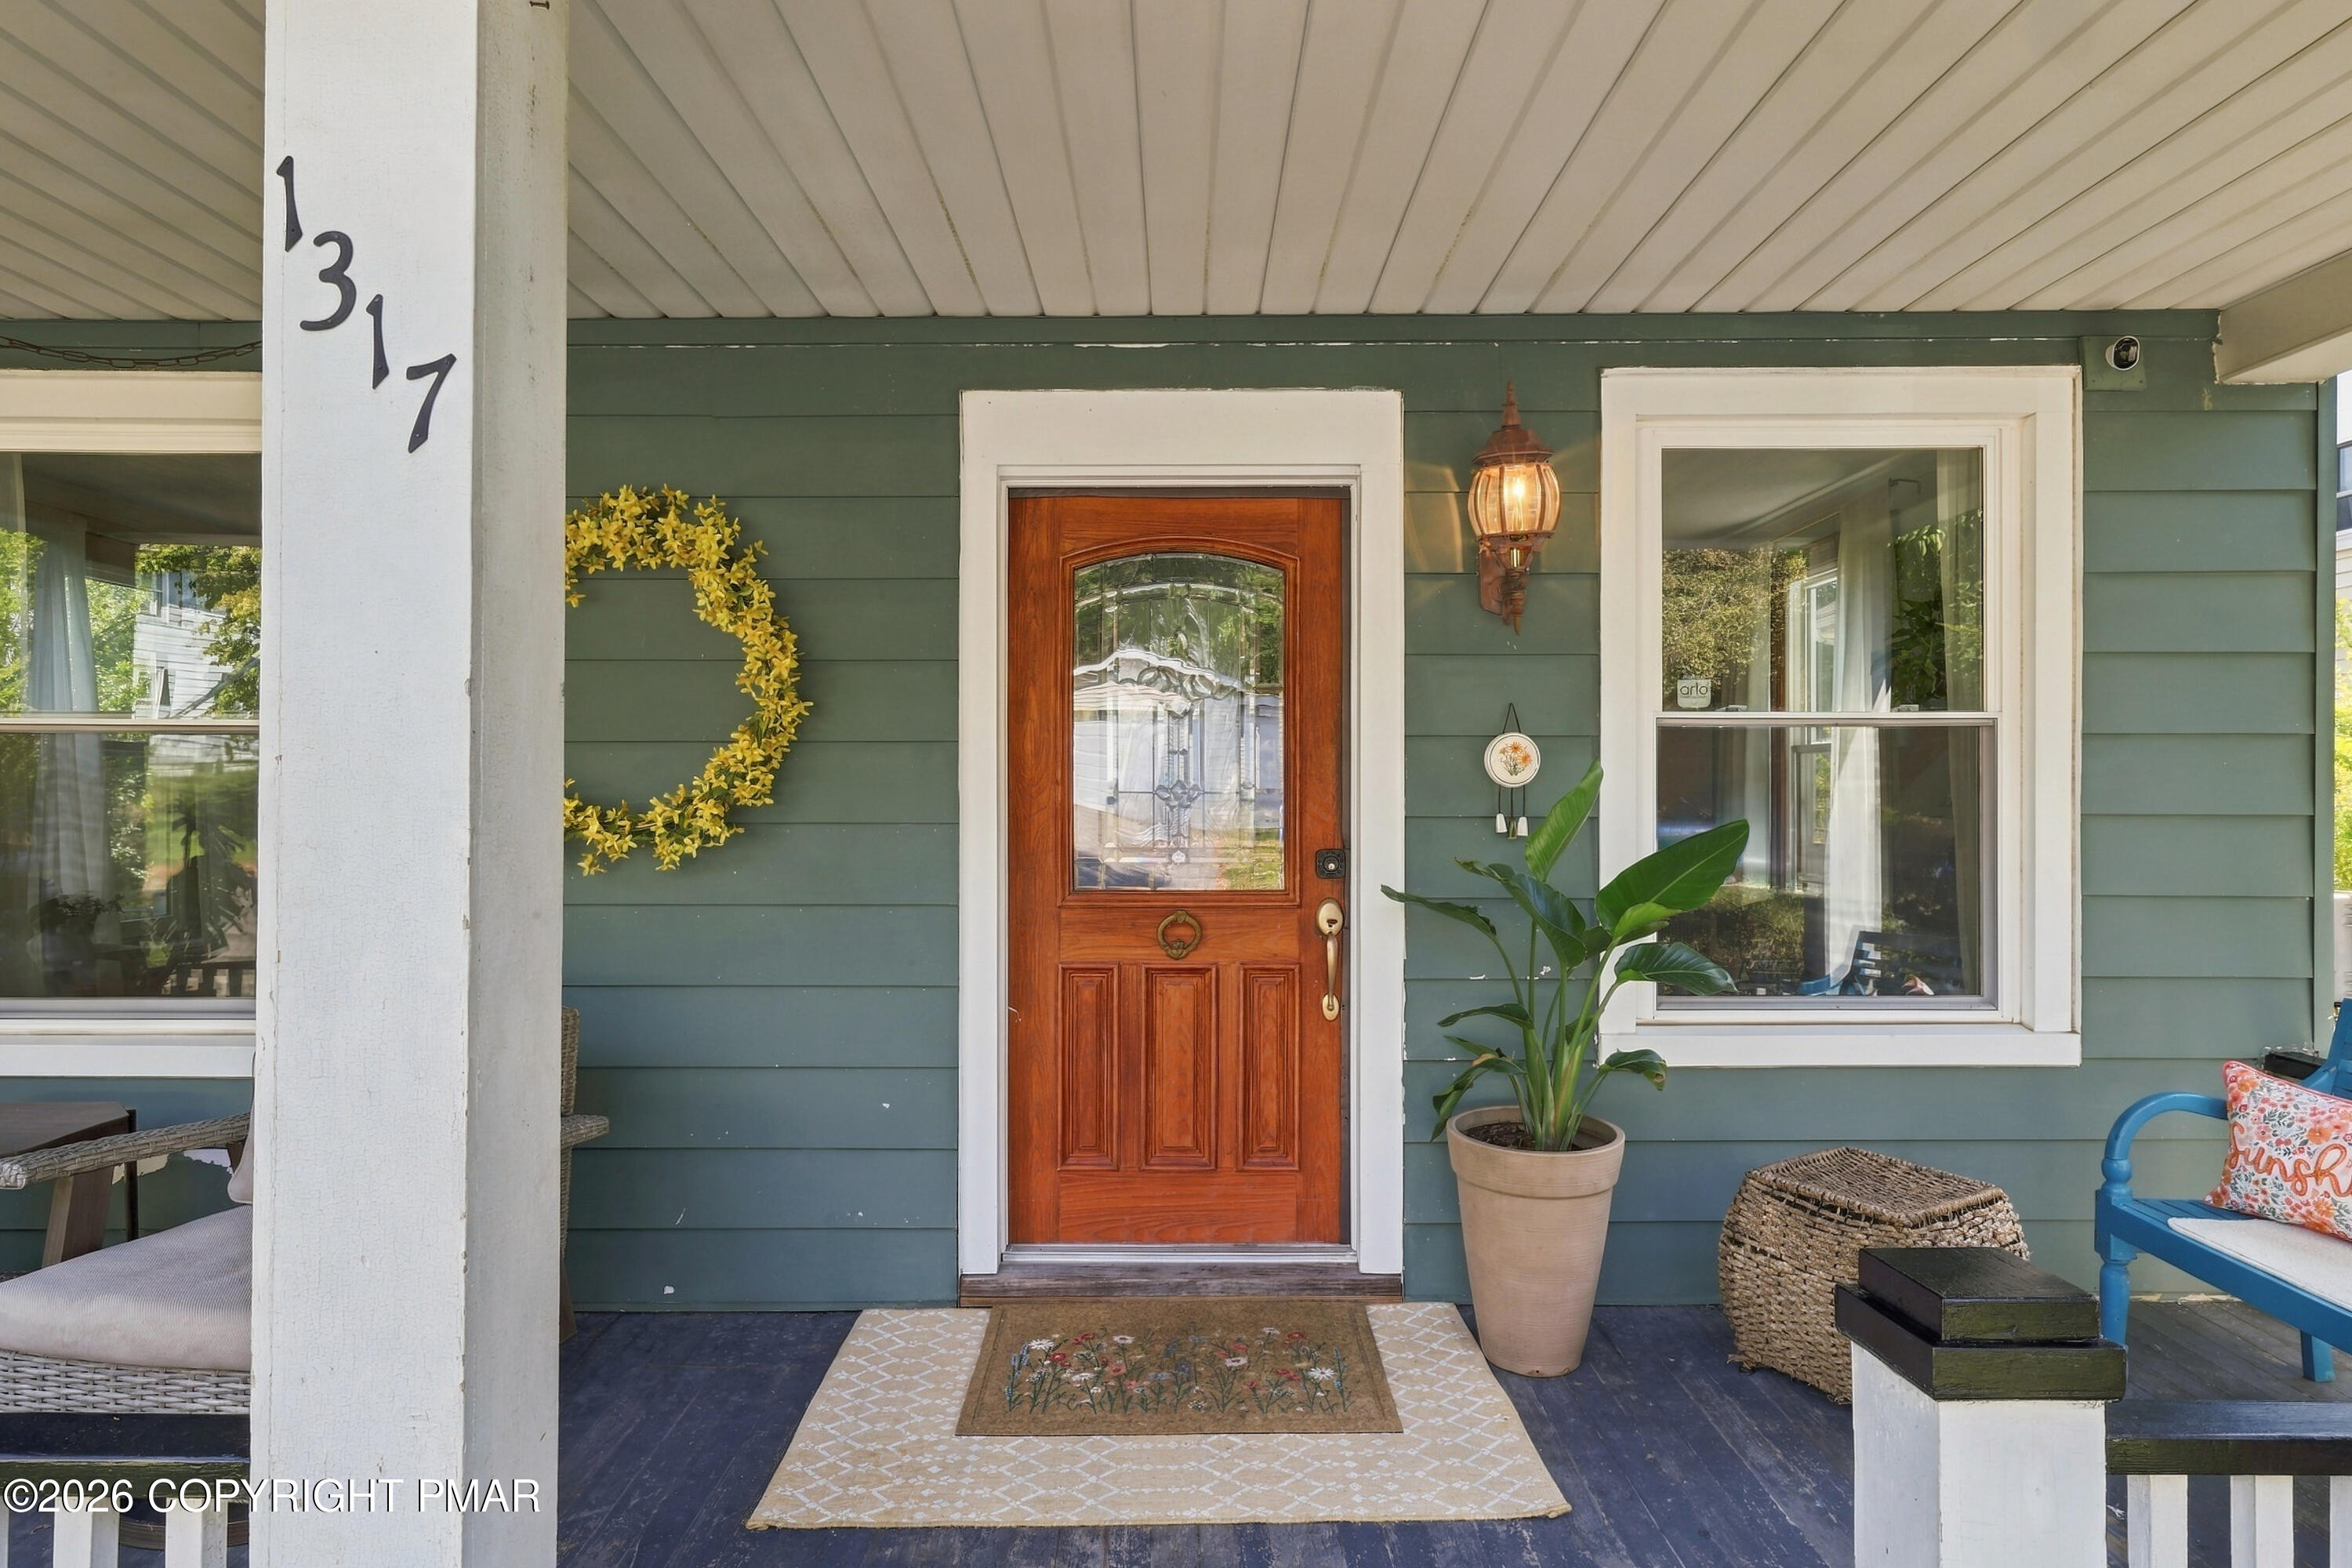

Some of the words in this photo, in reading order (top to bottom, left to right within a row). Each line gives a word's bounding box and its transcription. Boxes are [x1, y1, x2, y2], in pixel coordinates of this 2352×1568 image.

[276, 155, 457, 454] 1317
[1679, 682, 1708, 695] arlo
[2229, 1121, 2352, 1198] Sunsh
